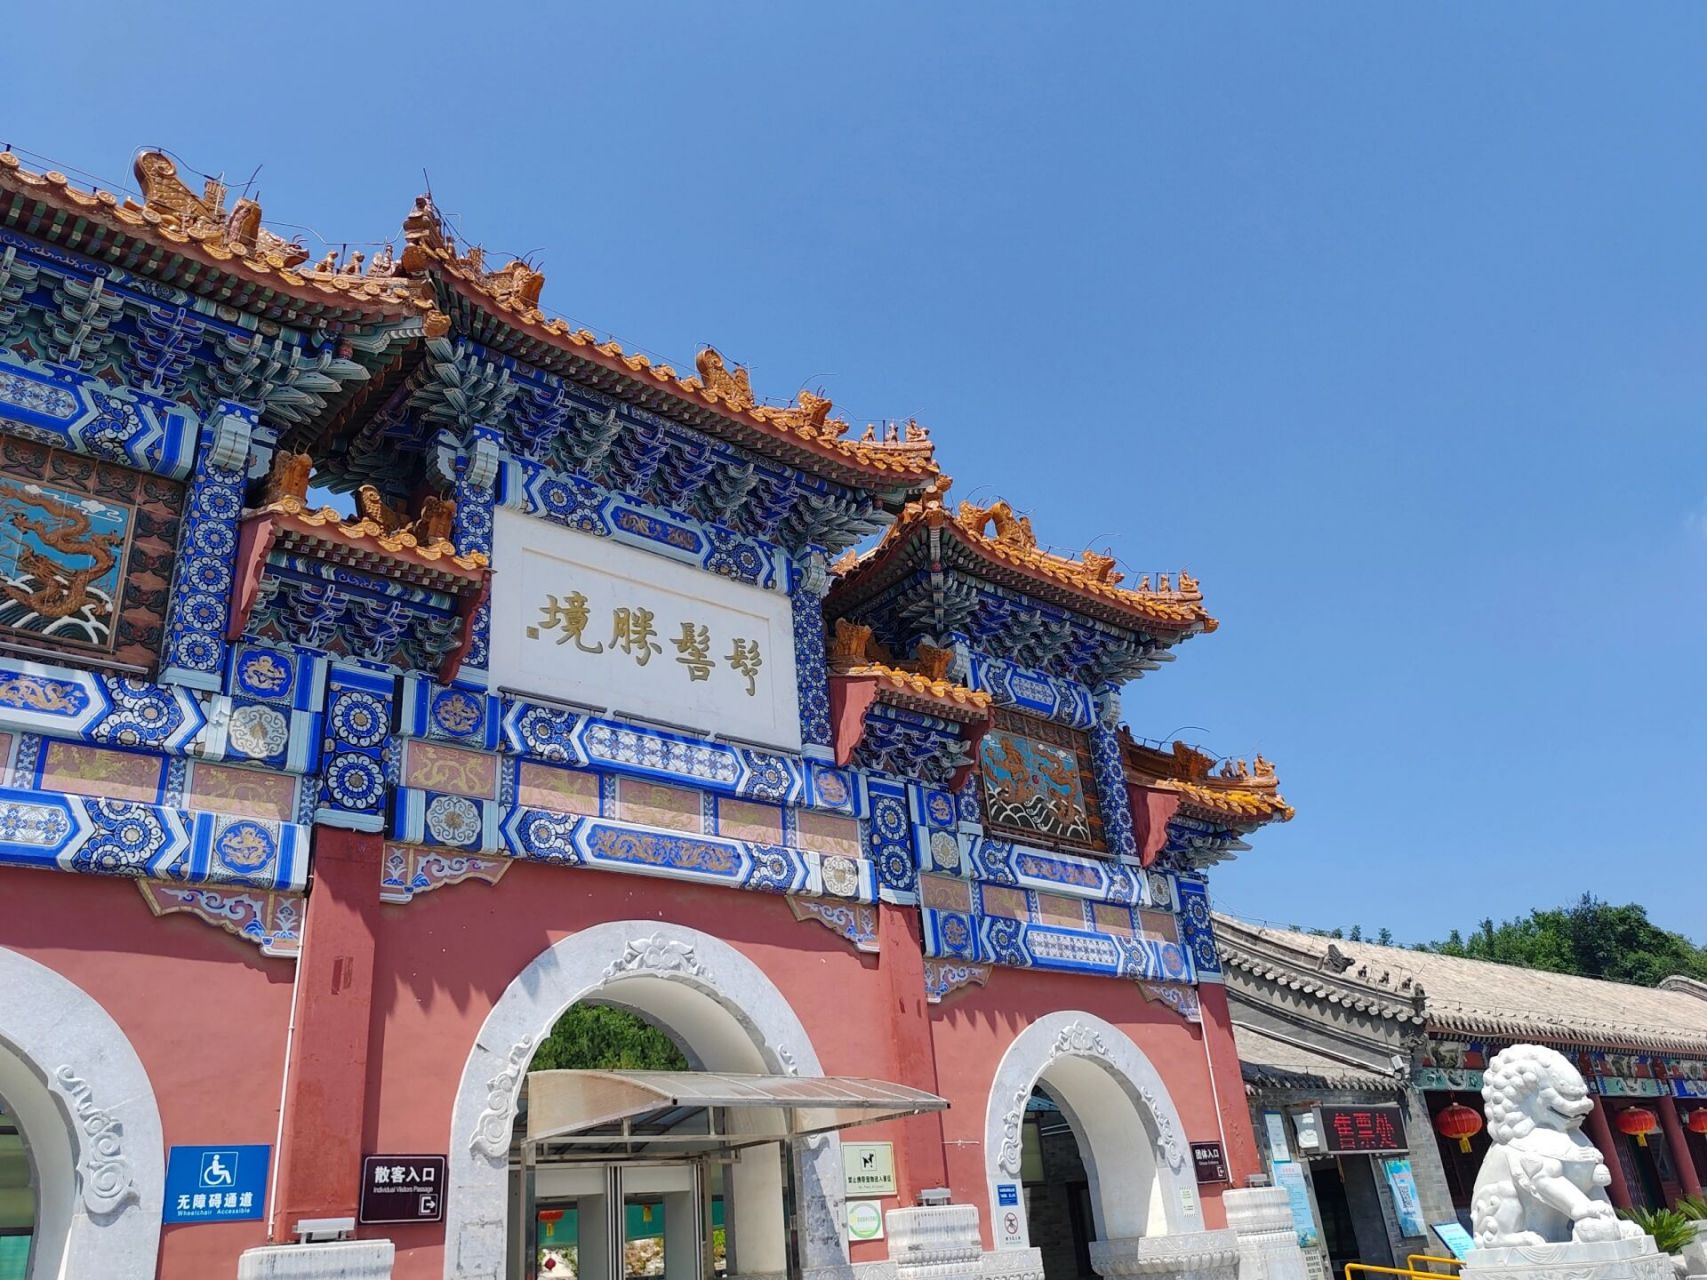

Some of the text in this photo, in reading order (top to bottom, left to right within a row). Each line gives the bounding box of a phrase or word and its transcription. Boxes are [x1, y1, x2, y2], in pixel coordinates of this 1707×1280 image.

[1333, 1113, 1398, 1148] 售票处
[375, 1166, 435, 1183] 散客入口
[177, 1192, 253, 1210] 无障碍通道
[216, 1207, 251, 1215] Accessible
